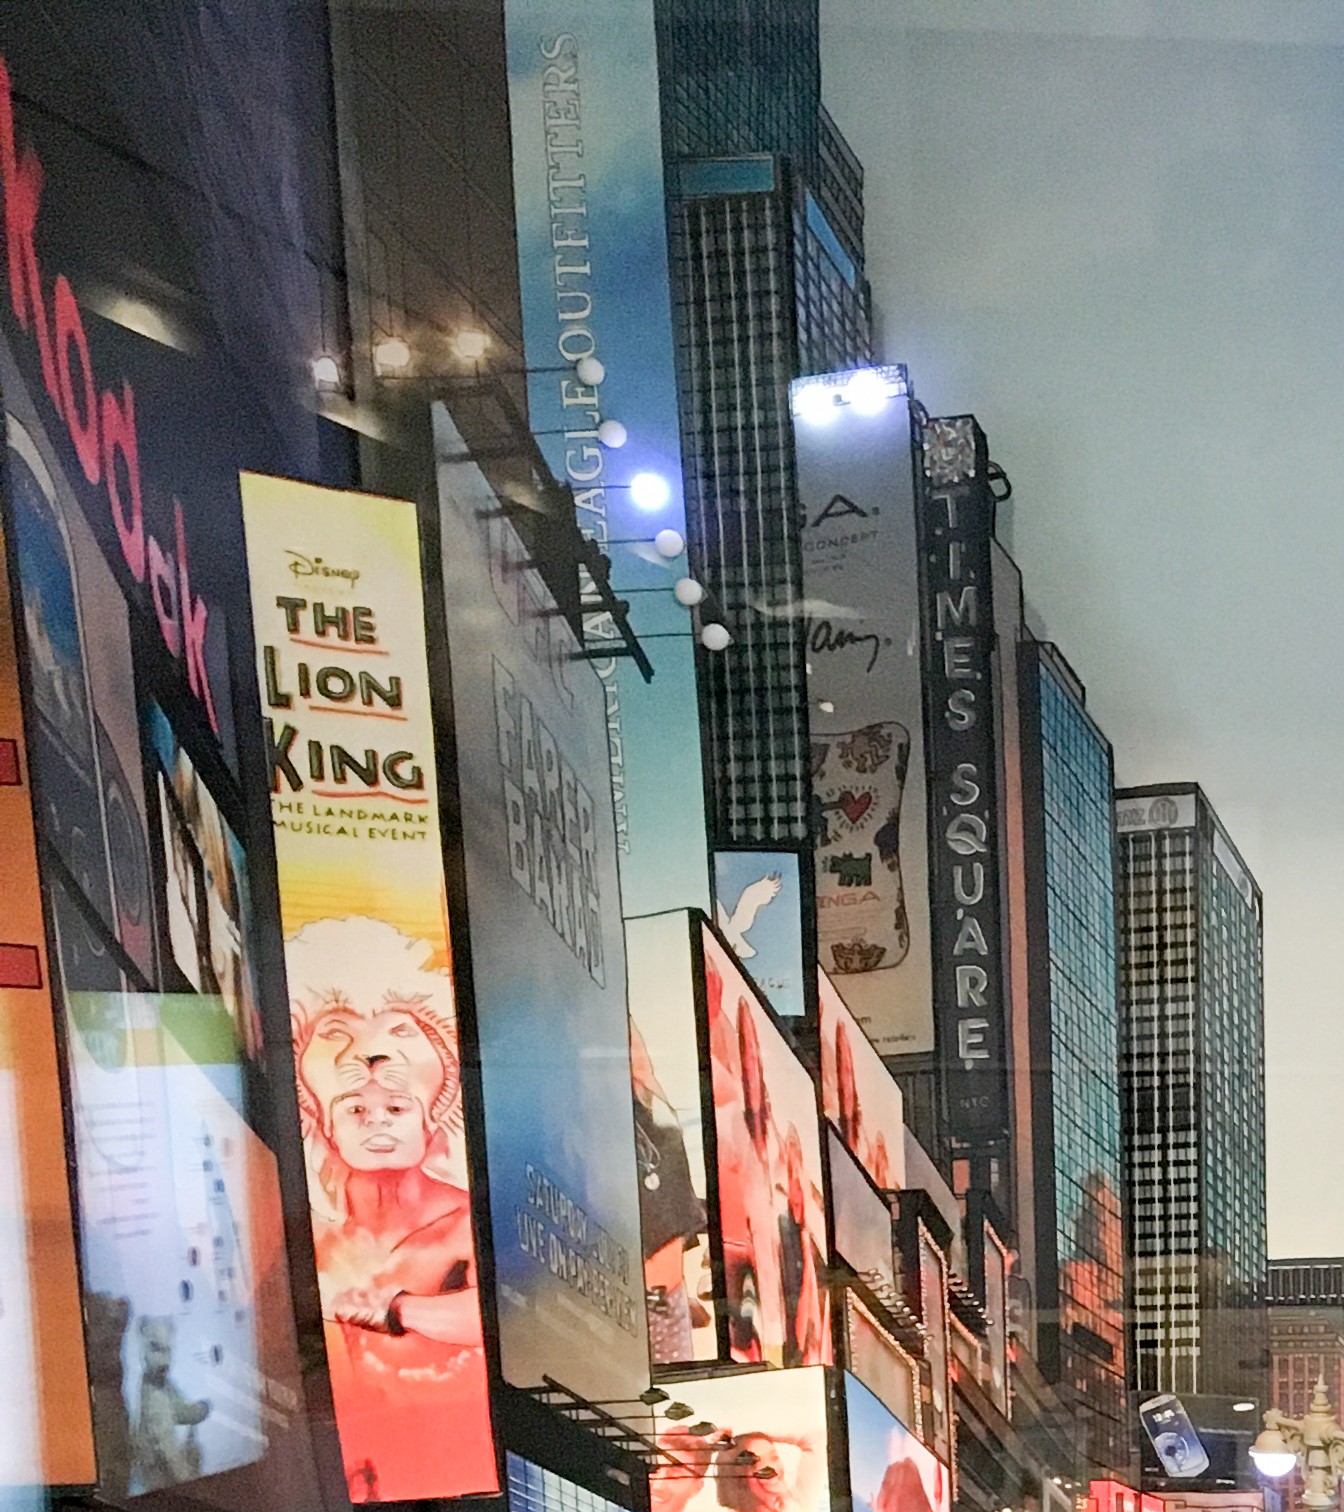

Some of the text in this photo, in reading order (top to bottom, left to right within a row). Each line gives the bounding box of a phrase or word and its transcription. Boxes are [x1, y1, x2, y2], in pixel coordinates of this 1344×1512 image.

[540, 32, 594, 360] OUTFITTERS
[275, 594, 378, 646] THE
[262, 645, 404, 710] LION
[263, 715, 426, 794] KING
[931, 495, 990, 1060] TIMES SQUARE
[273, 819, 428, 842] MUSICAL EVENT
[311, 803, 430, 824] LANDMARK
